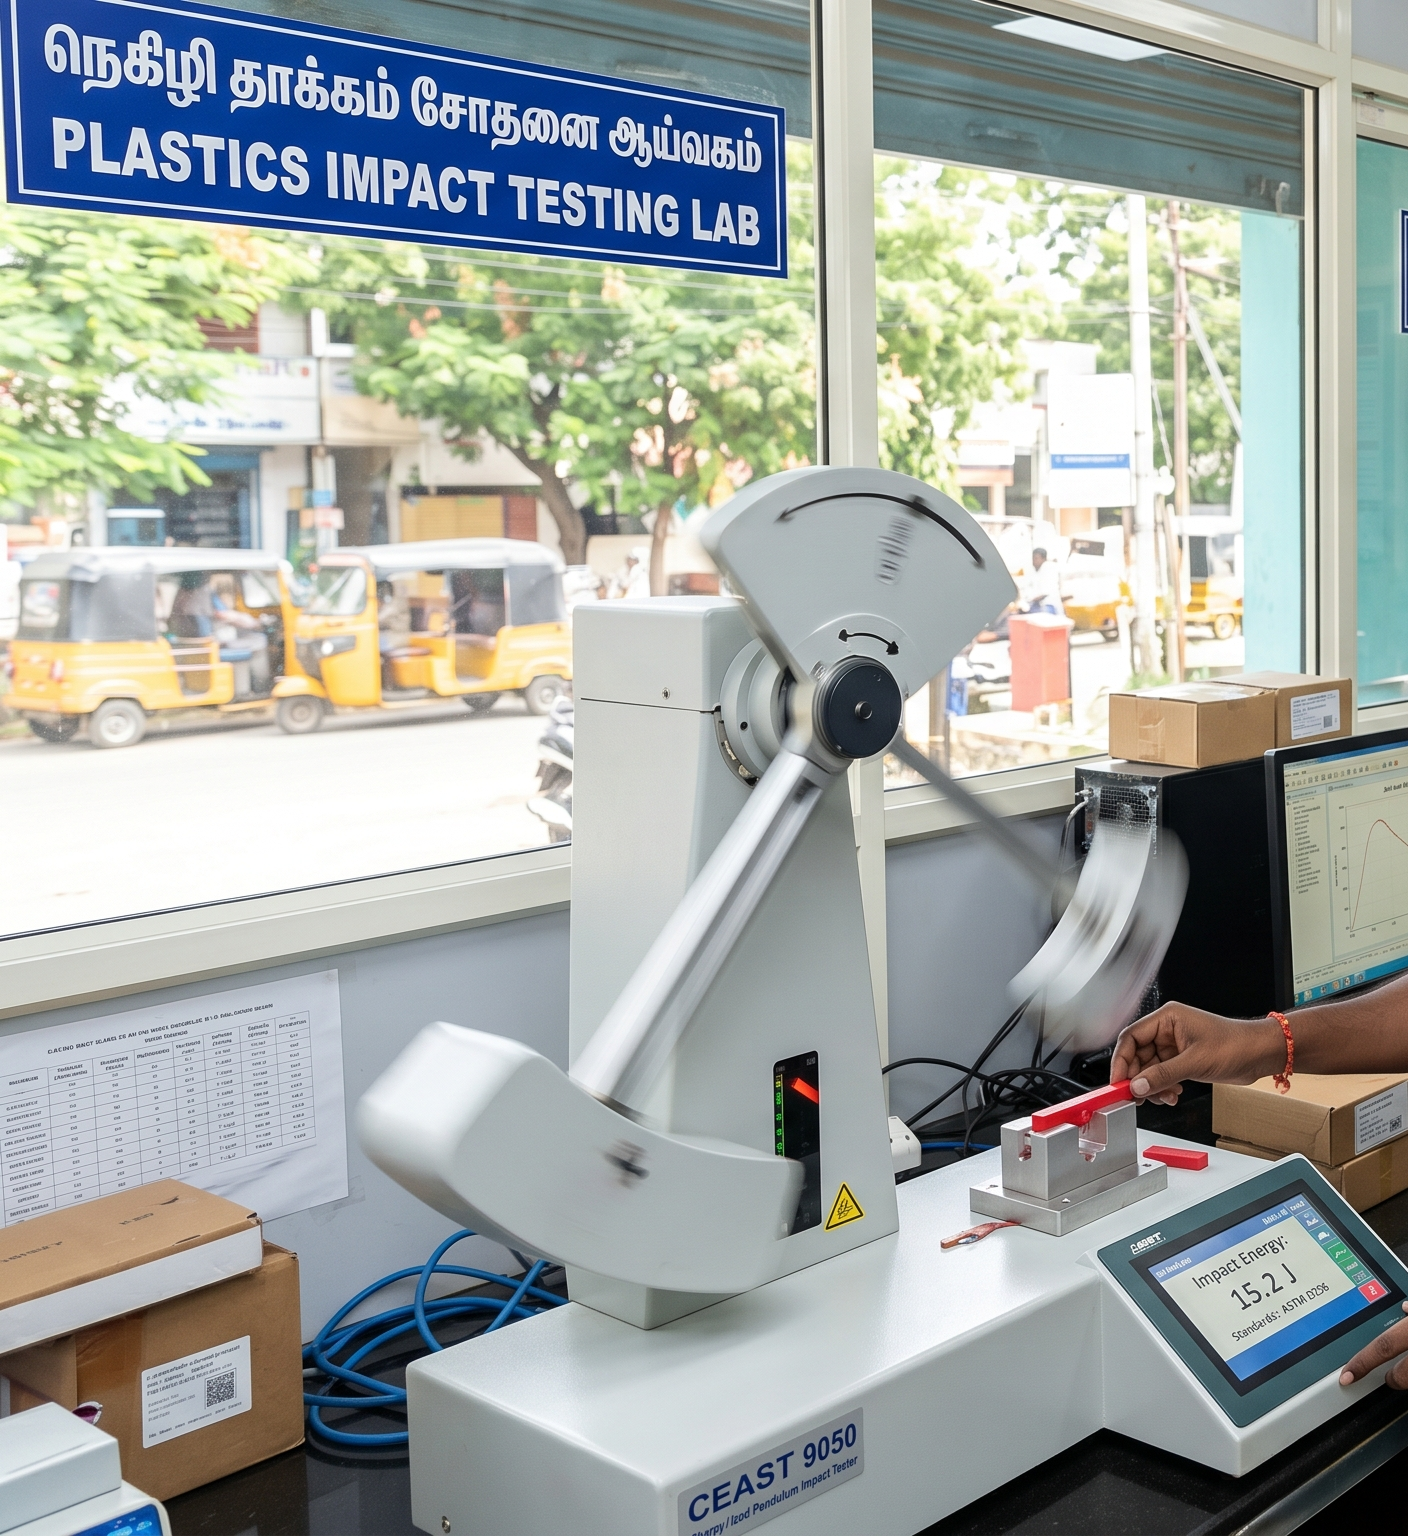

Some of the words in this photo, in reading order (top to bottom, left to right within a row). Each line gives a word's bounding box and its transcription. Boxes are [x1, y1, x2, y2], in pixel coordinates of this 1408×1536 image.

[45, 24, 216, 108] நெகிழி
[229, 54, 400, 119] தாக்கம்
[411, 76, 599, 151] சோதனை
[608, 113, 762, 173] ஆய்வகம்
[53, 117, 310, 196] PLASTICS
[327, 151, 495, 216] IMPACT
[508, 174, 680, 237] TESTING
[692, 198, 760, 246] LAB
[1191, 1258, 1242, 1290] Impact
[1238, 1234, 1289, 1266] Energy:
[1230, 1272, 1284, 1311] 15.2
[1281, 1262, 1297, 1284] J
[687, 1450, 795, 1523] CEAST
[802, 1423, 857, 1468] 9050
[752, 1485, 799, 1516] Pendulum
[801, 1469, 831, 1492] Impact
